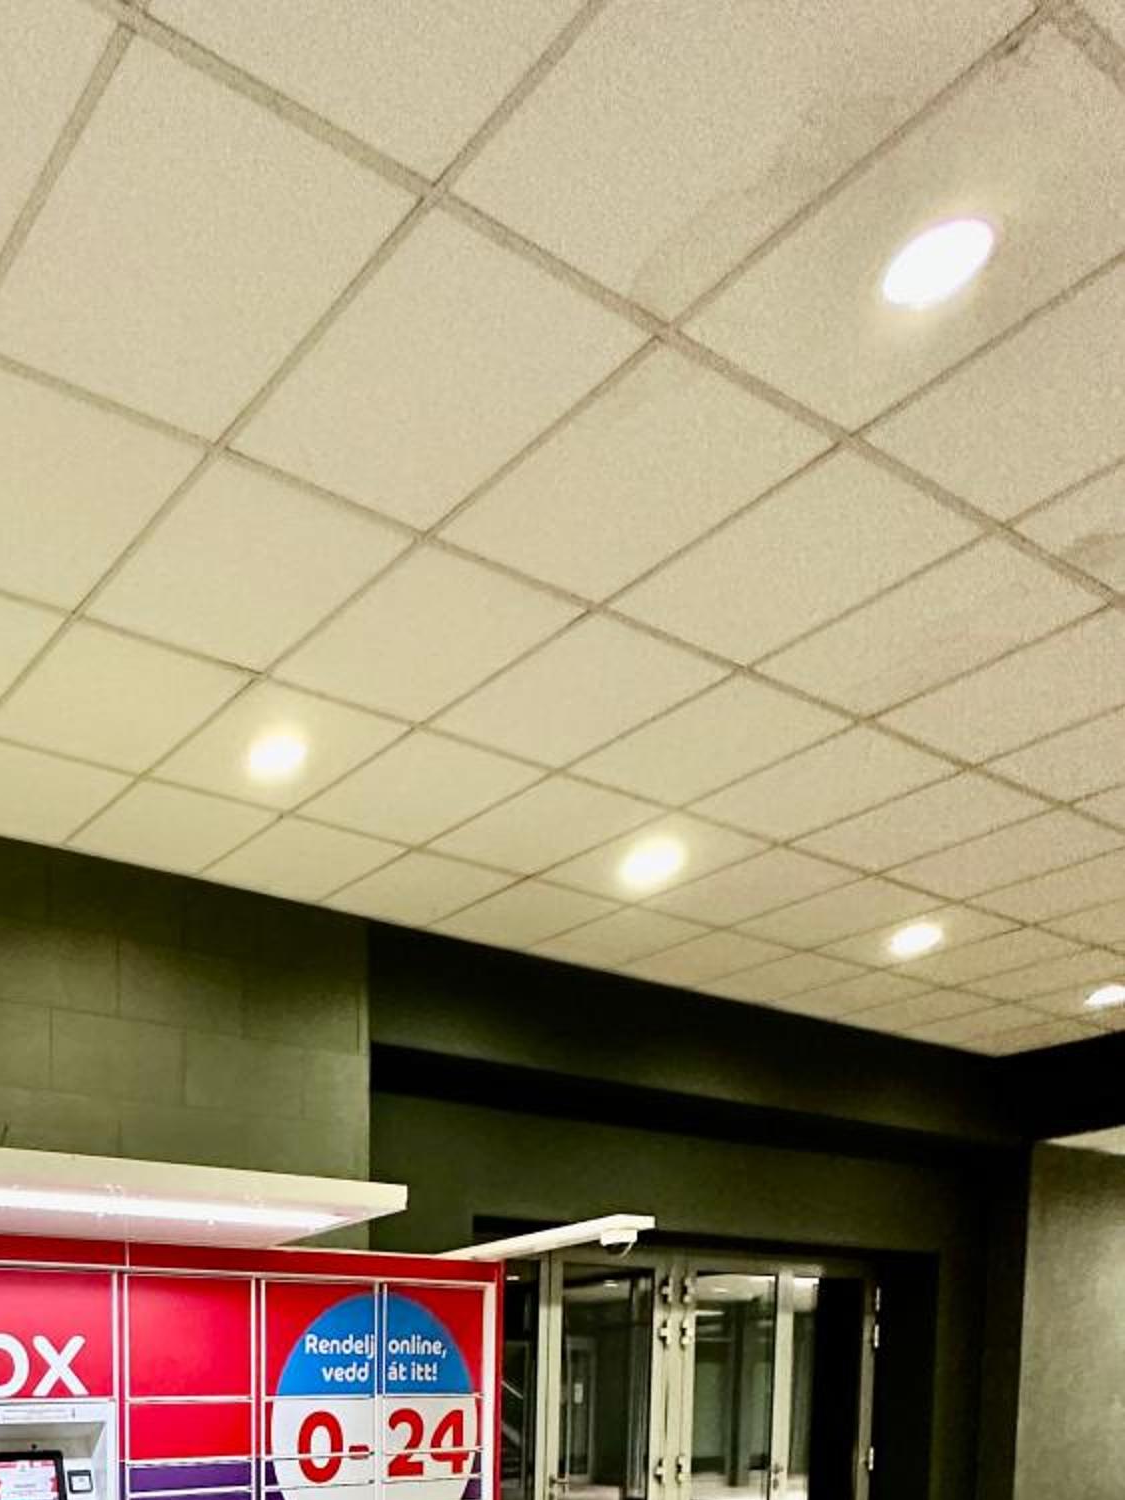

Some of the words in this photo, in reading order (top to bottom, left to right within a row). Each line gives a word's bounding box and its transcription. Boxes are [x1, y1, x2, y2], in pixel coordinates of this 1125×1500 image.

[304, 1333, 375, 1357] Rendelj
[388, 1334, 447, 1358] online,
[322, 1362, 370, 1382] vedd
[387, 1362, 408, 1381] át
[411, 1362, 438, 1381] itt!
